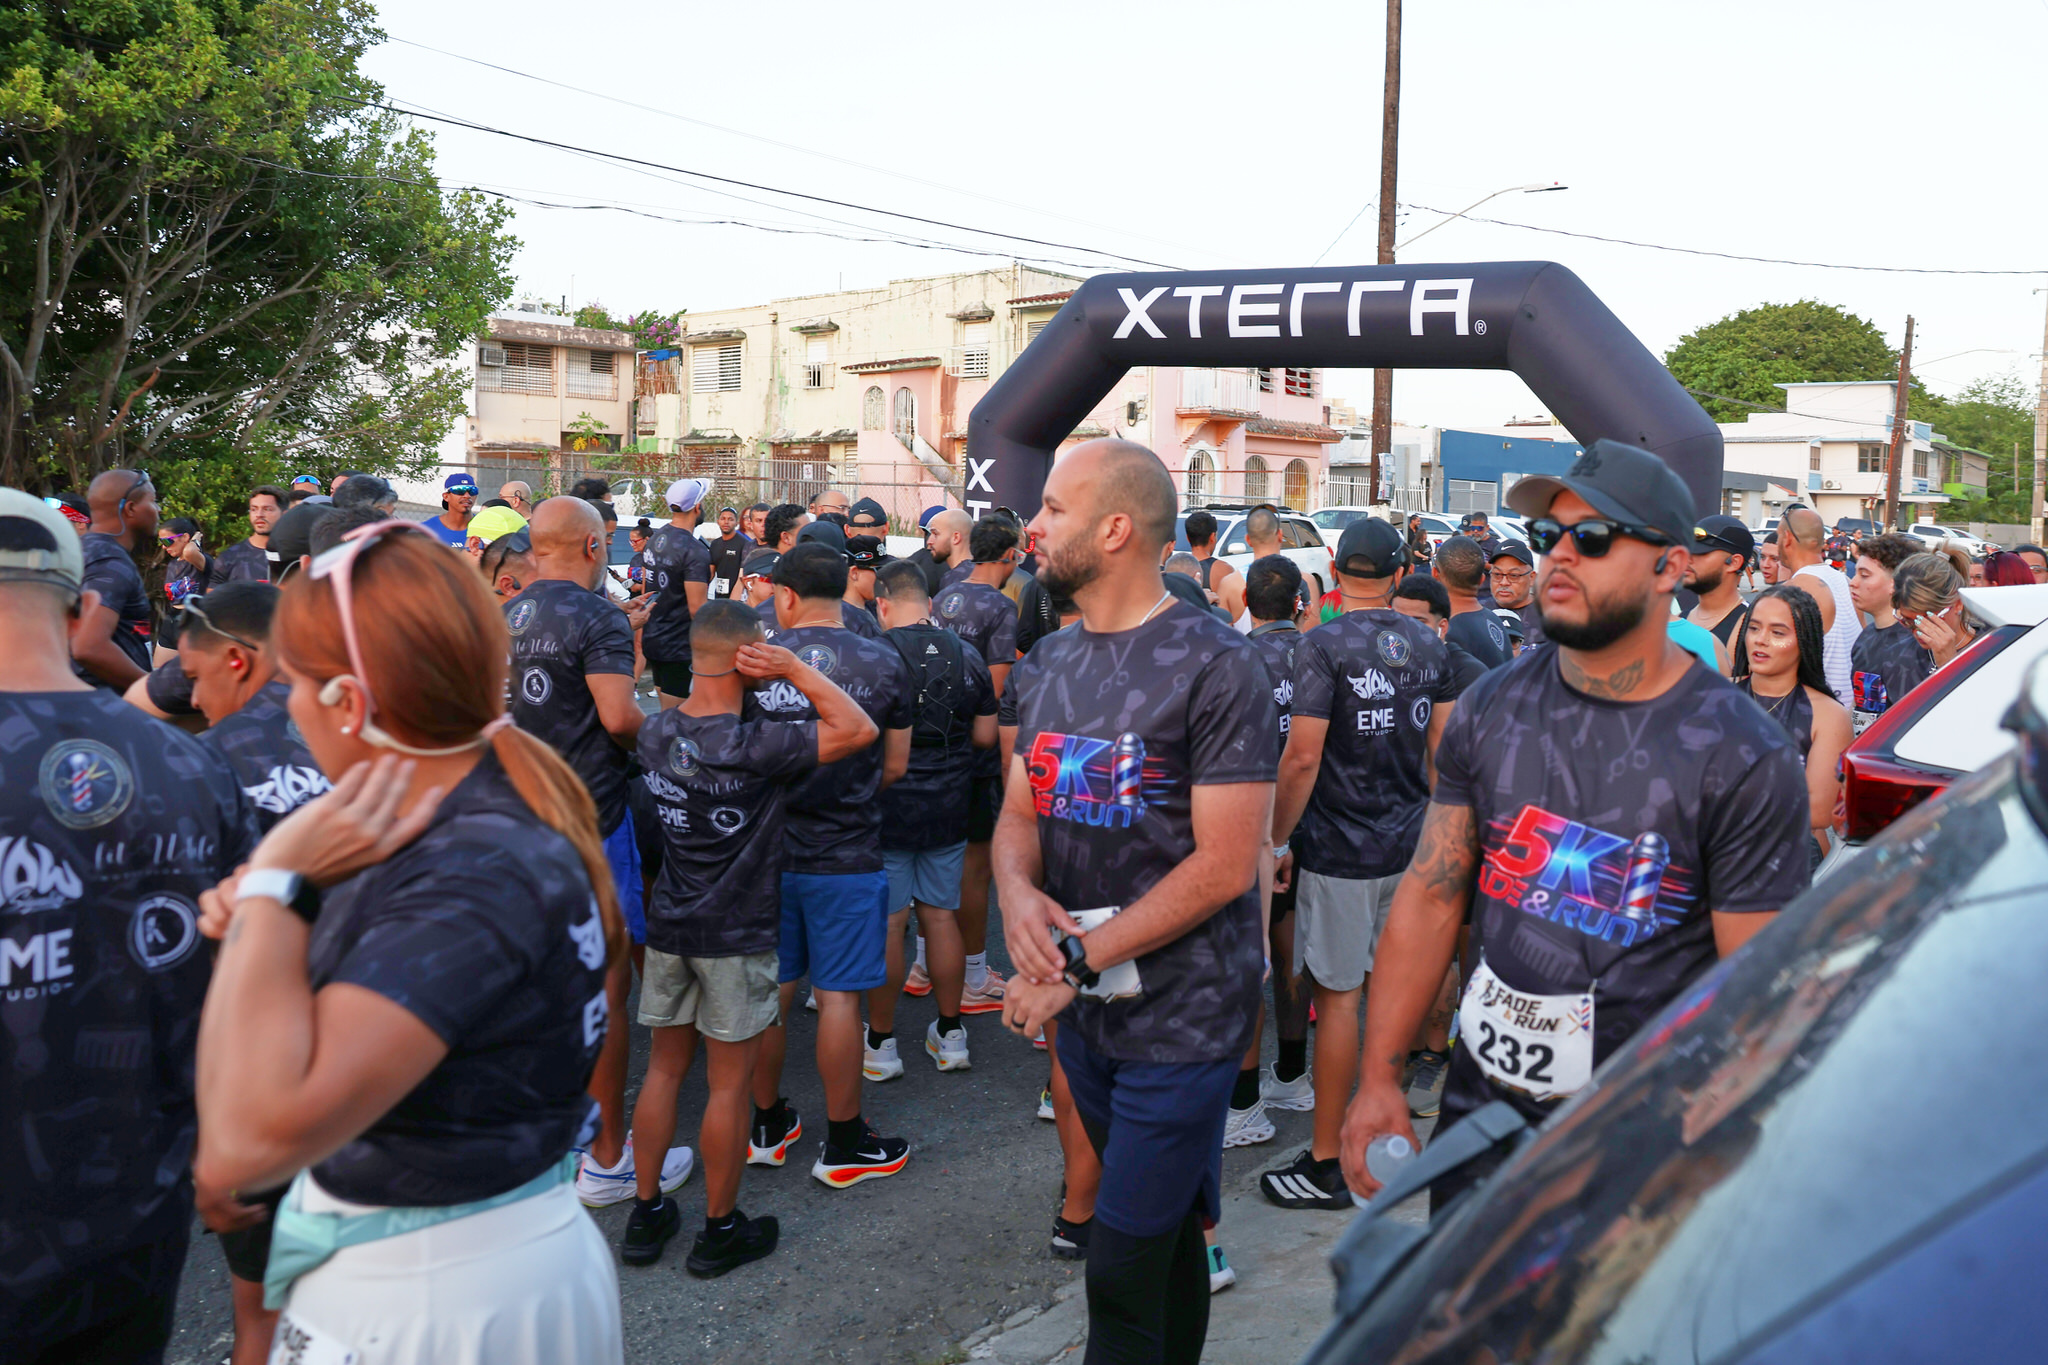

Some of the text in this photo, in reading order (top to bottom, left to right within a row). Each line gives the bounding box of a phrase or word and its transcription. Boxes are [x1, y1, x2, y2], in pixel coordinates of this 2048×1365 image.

[1357, 707, 1395, 730] EME
[1029, 731, 1114, 799] 5K
[1052, 796, 1070, 820] &
[1068, 798, 1132, 829] RUN
[1484, 804, 1632, 904] 5K
[1521, 889, 1551, 919] &
[1549, 895, 1639, 948] RUN
[1495, 984, 1542, 1016] FADE
[1514, 1014, 1559, 1033] RUN
[1478, 1019, 1554, 1084] 232
